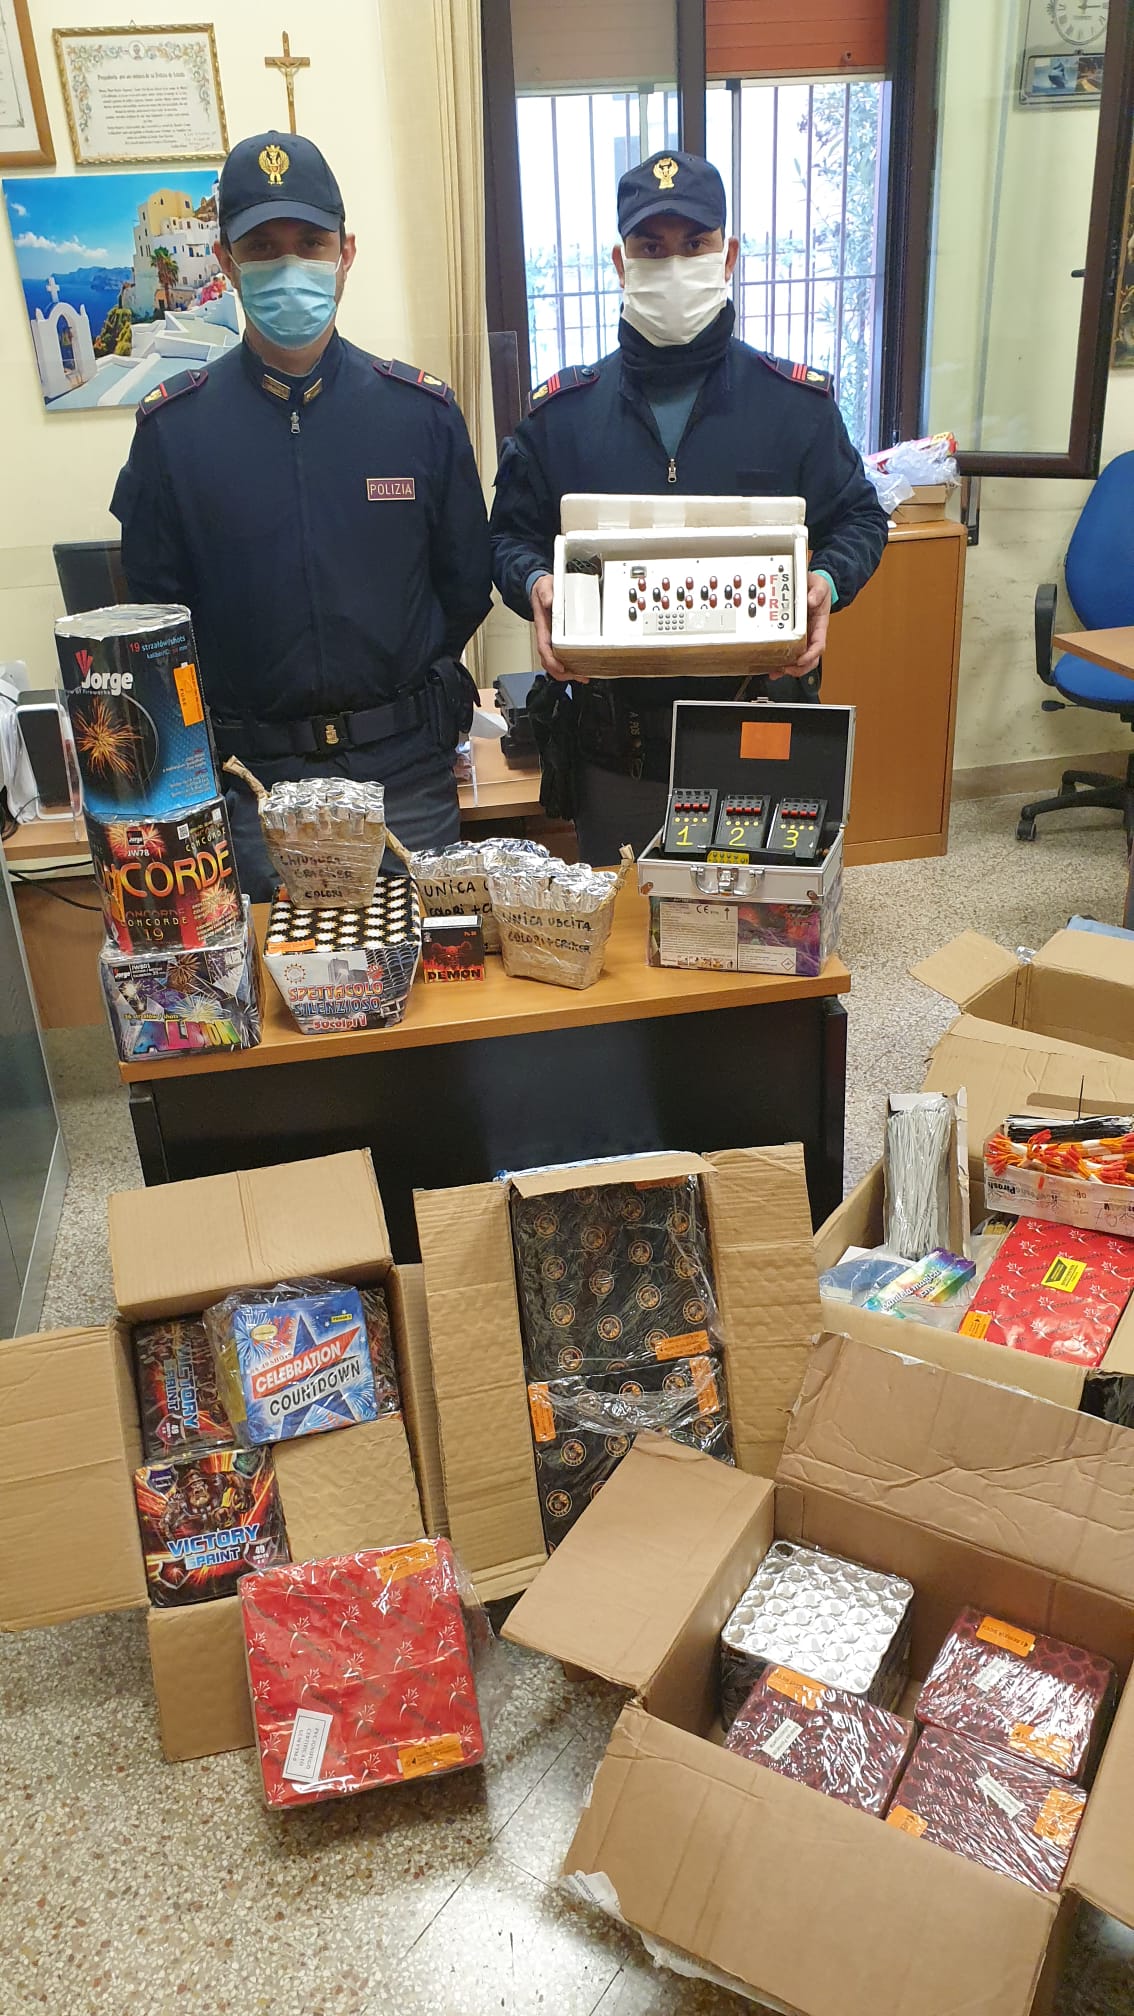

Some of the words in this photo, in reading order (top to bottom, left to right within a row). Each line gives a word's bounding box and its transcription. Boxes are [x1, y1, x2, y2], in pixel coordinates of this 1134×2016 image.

[370, 483, 412, 496] POLIZIA
[769, 574, 778, 621] FIRE
[81, 668, 133, 696] Jorge
[676, 826, 693, 846] 1
[729, 828, 746, 846] 2
[783, 830, 799, 848] 3
[697, 904, 709, 914] CE
[428, 968, 480, 980] DEMON
[288, 981, 384, 1002] SPETTACOLO
[293, 996, 381, 1016] SILENZIOSO
[256, 1341, 341, 1393] CELEBRATION
[176, 1341, 200, 1429] VICTORY
[269, 1359, 360, 1416] COUNTDOWN
[168, 1523, 260, 1558] VICTORY
[185, 1546, 241, 1570] SPRINT
